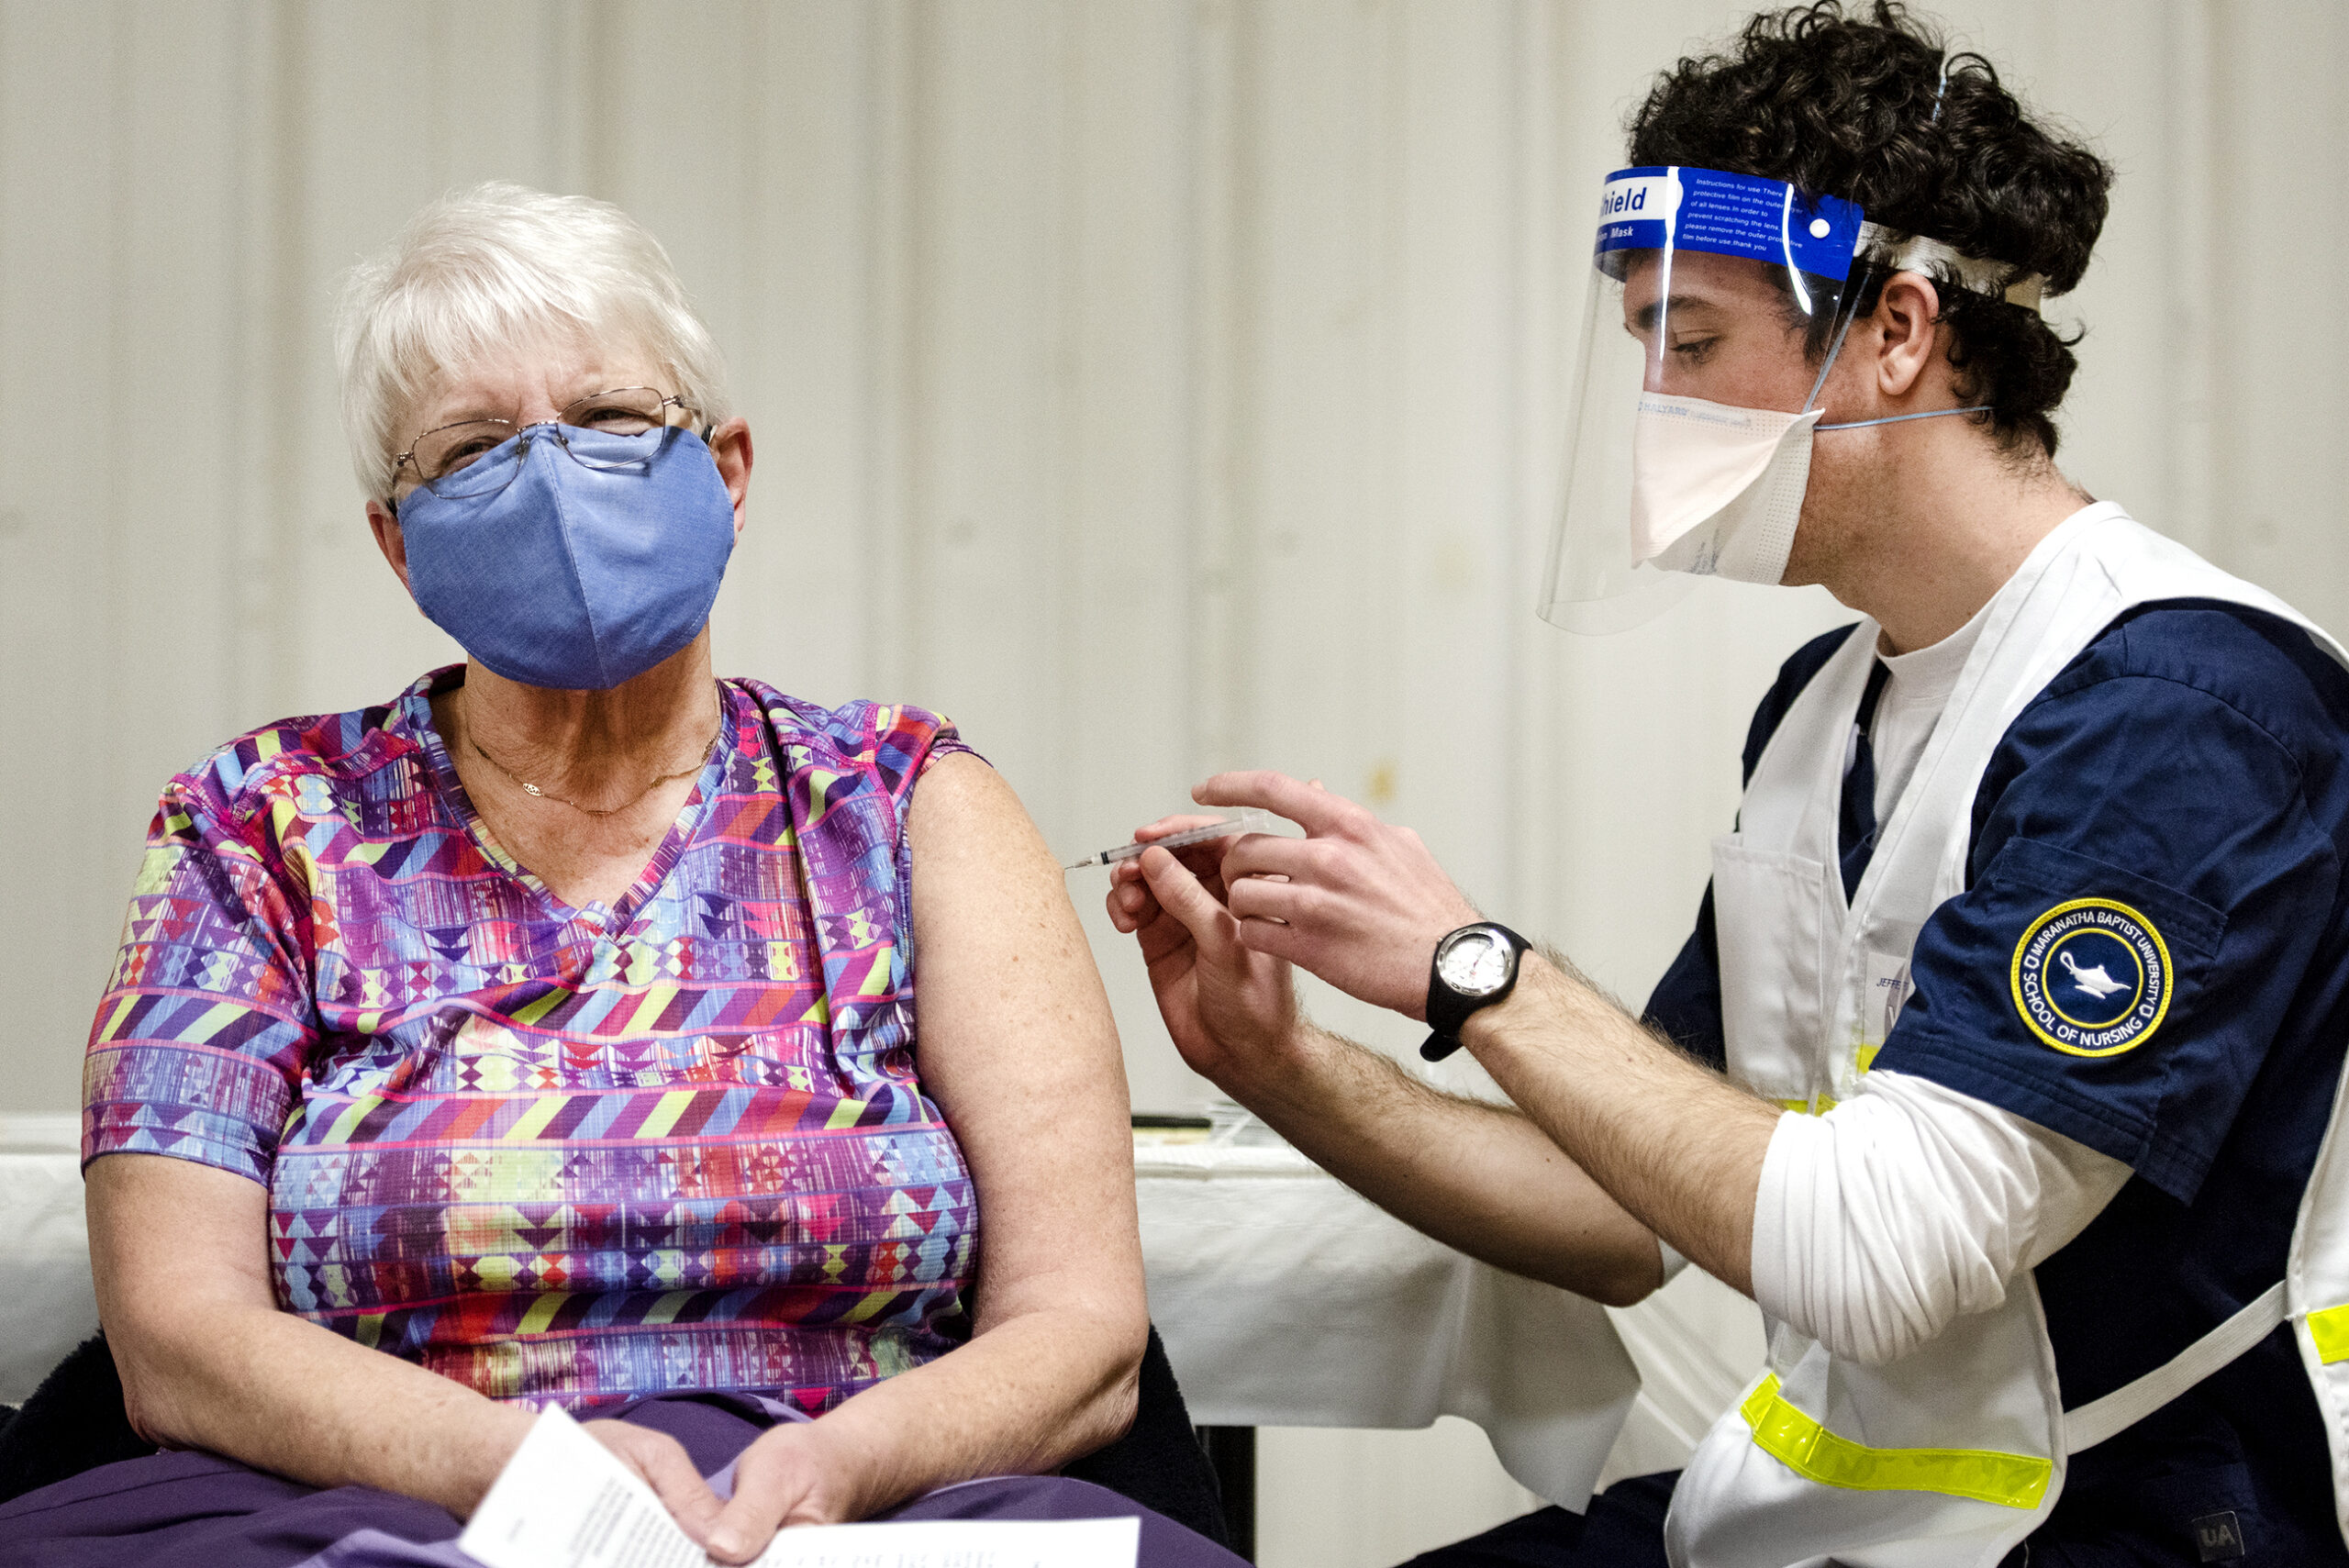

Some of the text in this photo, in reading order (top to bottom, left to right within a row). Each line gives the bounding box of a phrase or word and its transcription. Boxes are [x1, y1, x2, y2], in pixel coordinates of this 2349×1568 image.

[1697, 178, 1734, 189] Instructions
[1763, 187, 1784, 196] There
[1693, 190, 1726, 199] protective
[1765, 200, 1784, 208] outer
[1709, 202, 1731, 211] lenses
[1741, 207, 1759, 216] order
[1687, 212, 1713, 220] prevent
[1714, 215, 1750, 226] scratching
[1751, 219, 1763, 228] the
[1610, 226, 1633, 239] Mask
[1709, 226, 1734, 234] remove
[1767, 235, 1803, 248] prottive
[1696, 235, 1718, 243] before
[1753, 243, 1767, 251] you
[2031, 911, 2161, 1006] MARANATHA BAPTIST UNIVERSITY
[2022, 973, 2143, 1047] SCHOOL OF NURSING
[2200, 1525, 2237, 1548] UA
